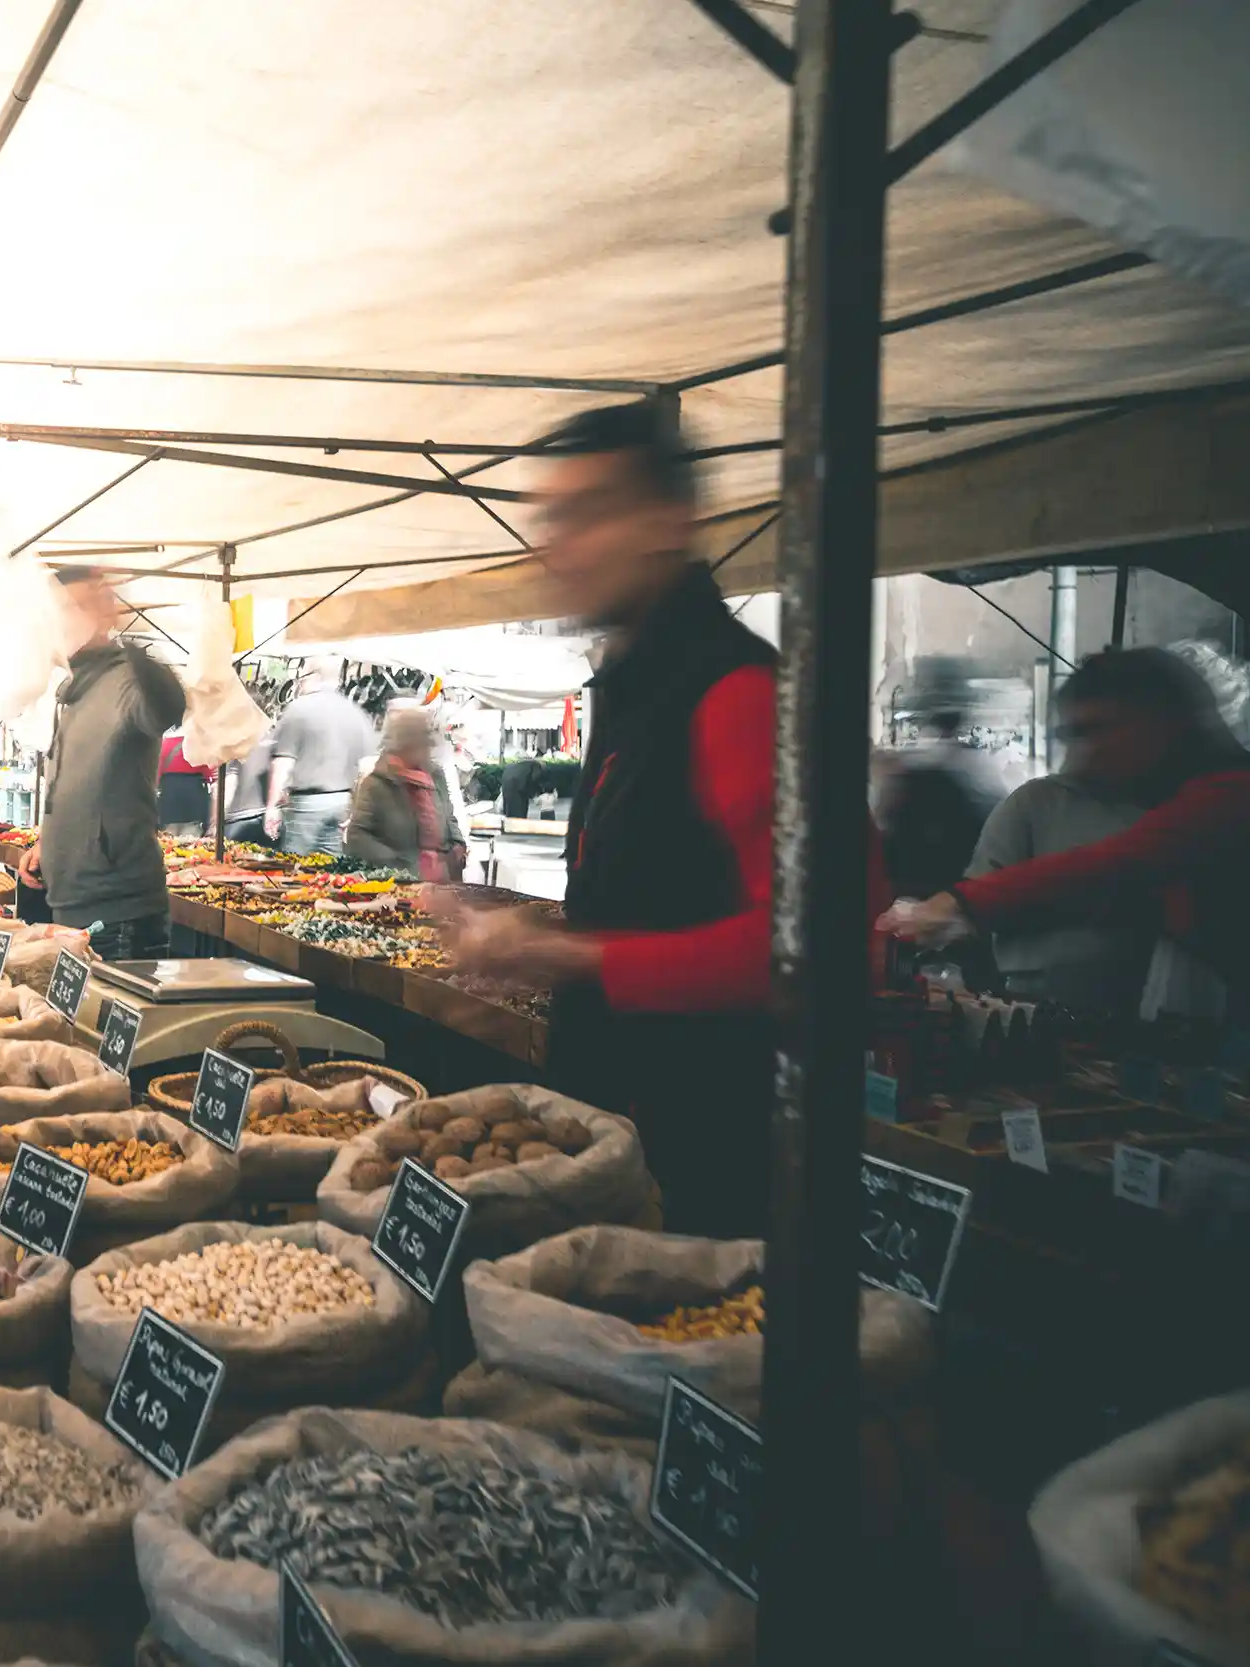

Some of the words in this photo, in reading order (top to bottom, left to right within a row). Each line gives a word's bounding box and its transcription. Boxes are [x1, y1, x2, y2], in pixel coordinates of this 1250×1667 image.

[205, 1096, 226, 1120] 1,50
[5, 1196, 15, 1215] €
[17, 1200, 45, 1228] 1,00
[386, 1216, 399, 1240] €
[398, 1224, 425, 1260] 1,50
[119, 1380, 134, 1409] €
[135, 1389, 168, 1431] 1,50
